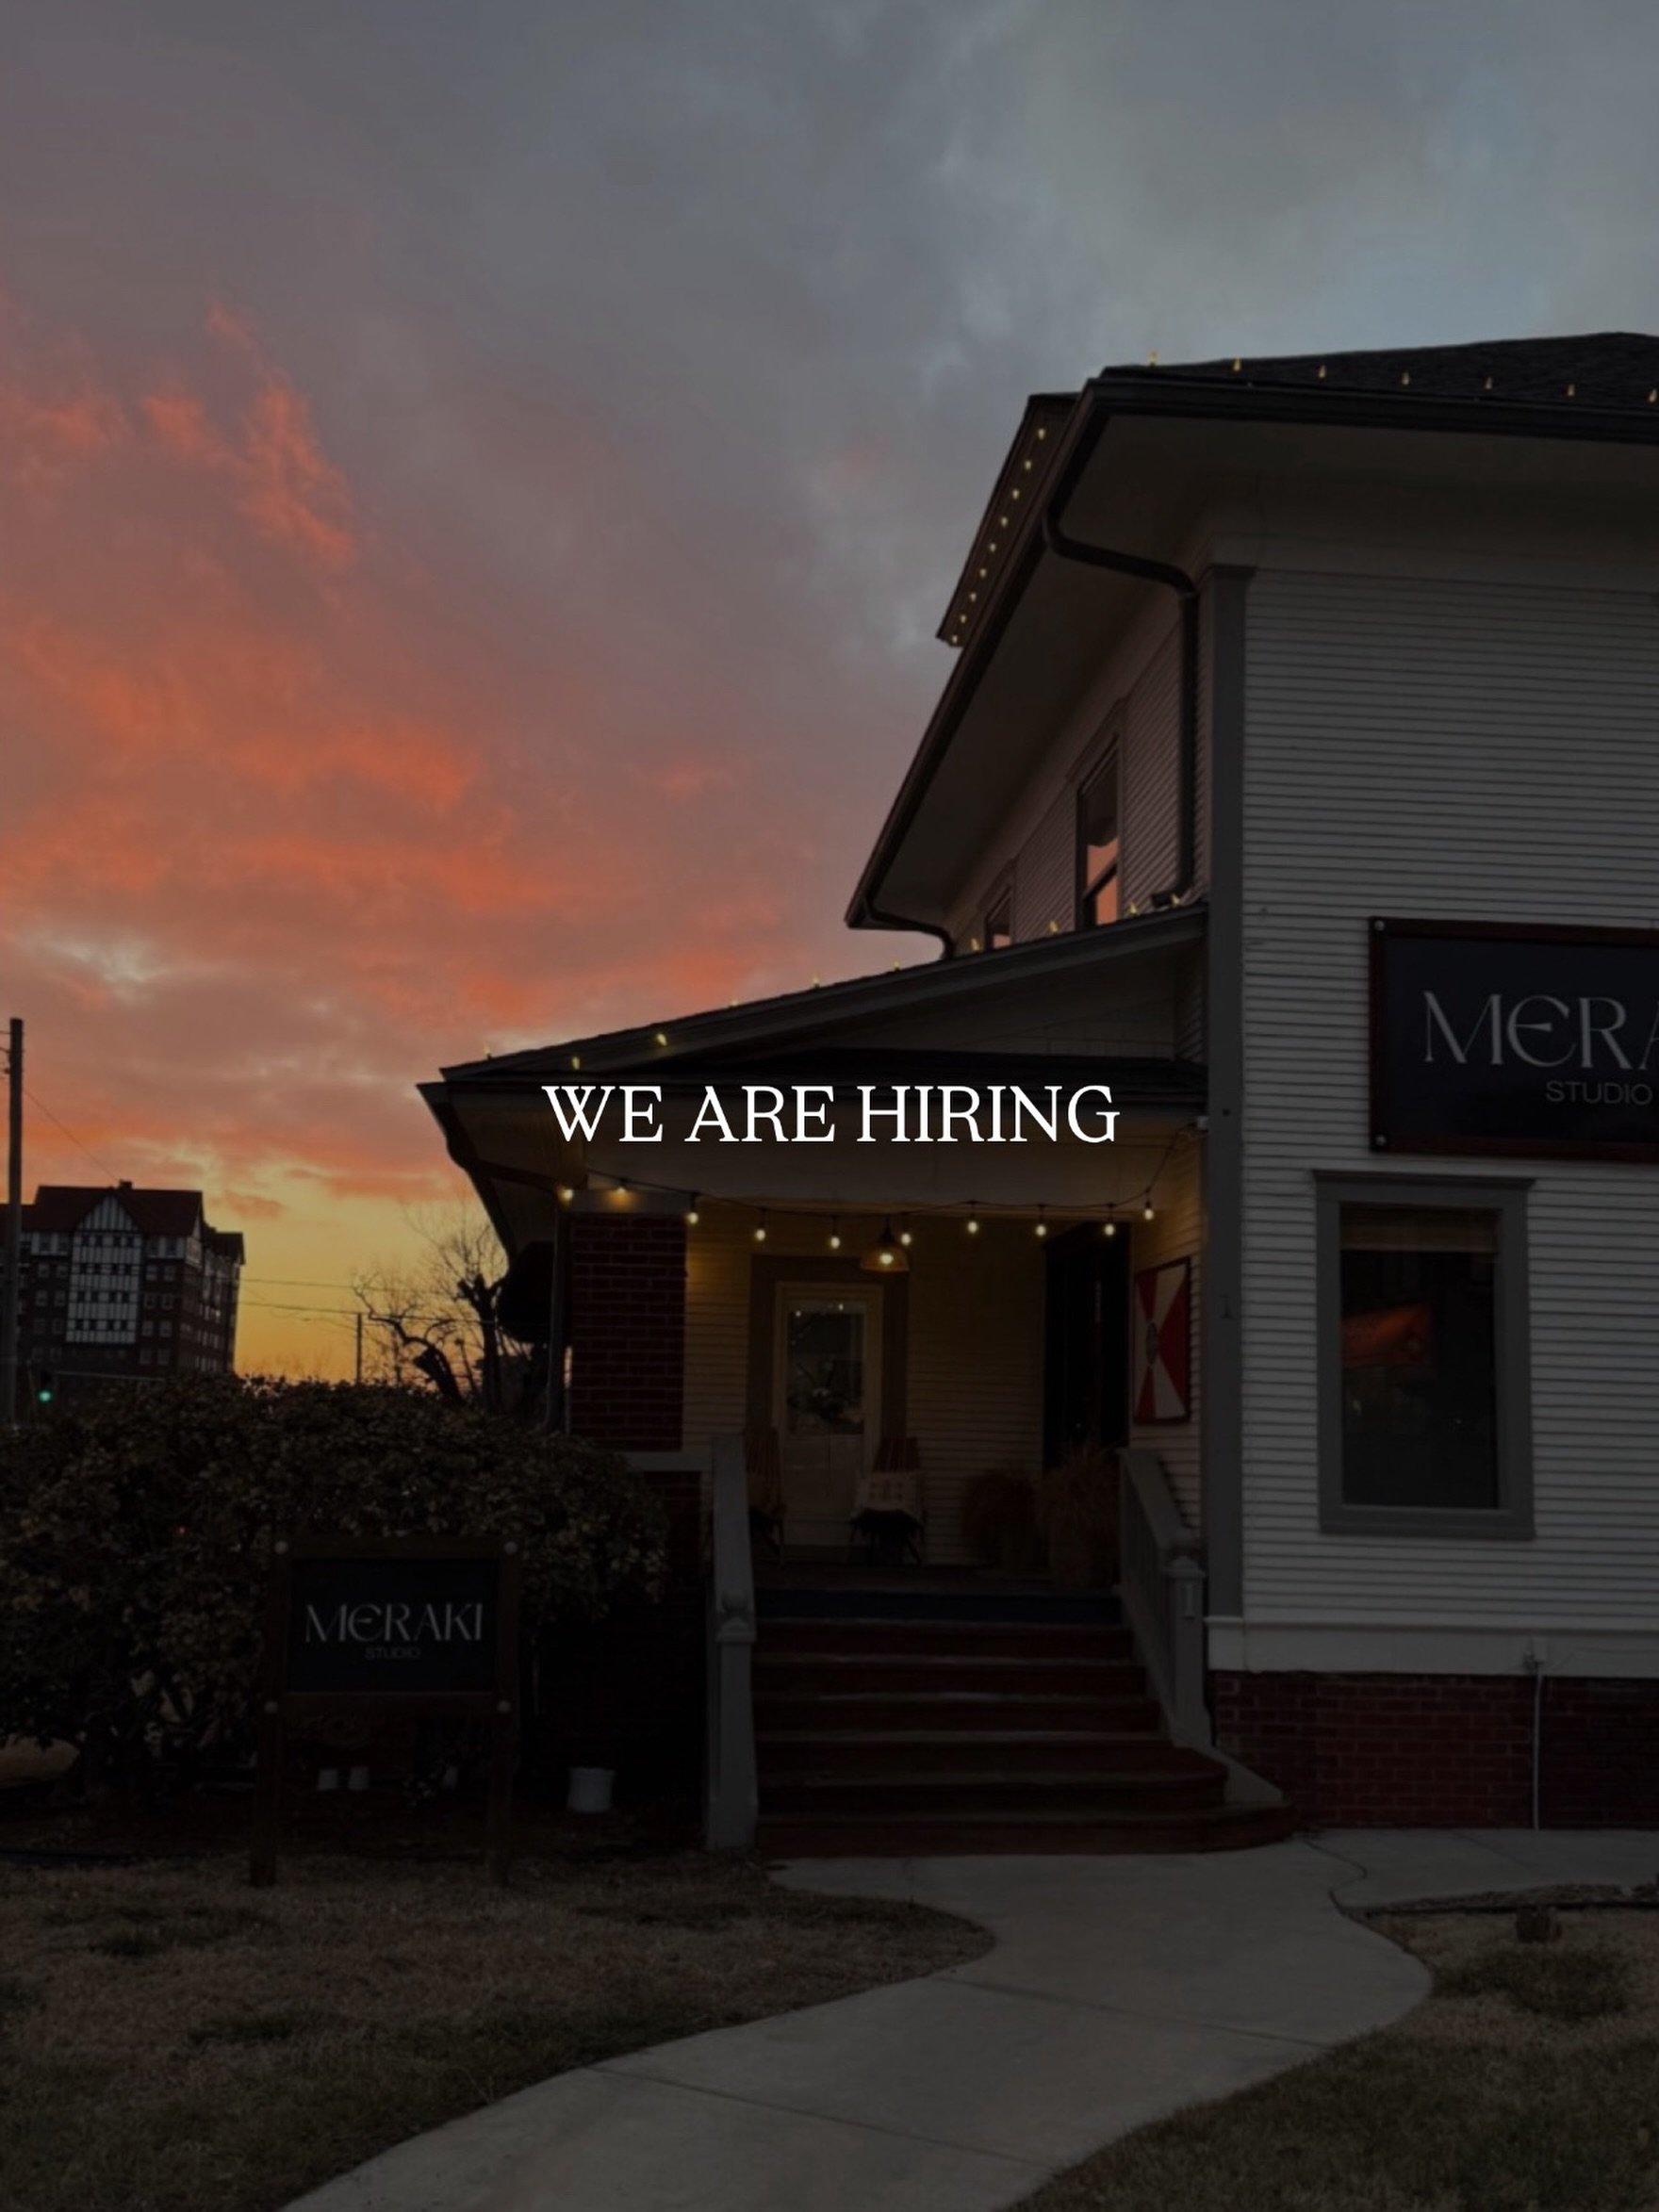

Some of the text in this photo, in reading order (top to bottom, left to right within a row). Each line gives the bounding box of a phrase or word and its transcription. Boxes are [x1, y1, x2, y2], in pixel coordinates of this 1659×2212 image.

[1545, 1080, 1653, 1106] STUDIO
[304, 1602, 483, 1643] MERAKI
[365, 1647, 421, 1661] STUDIO
